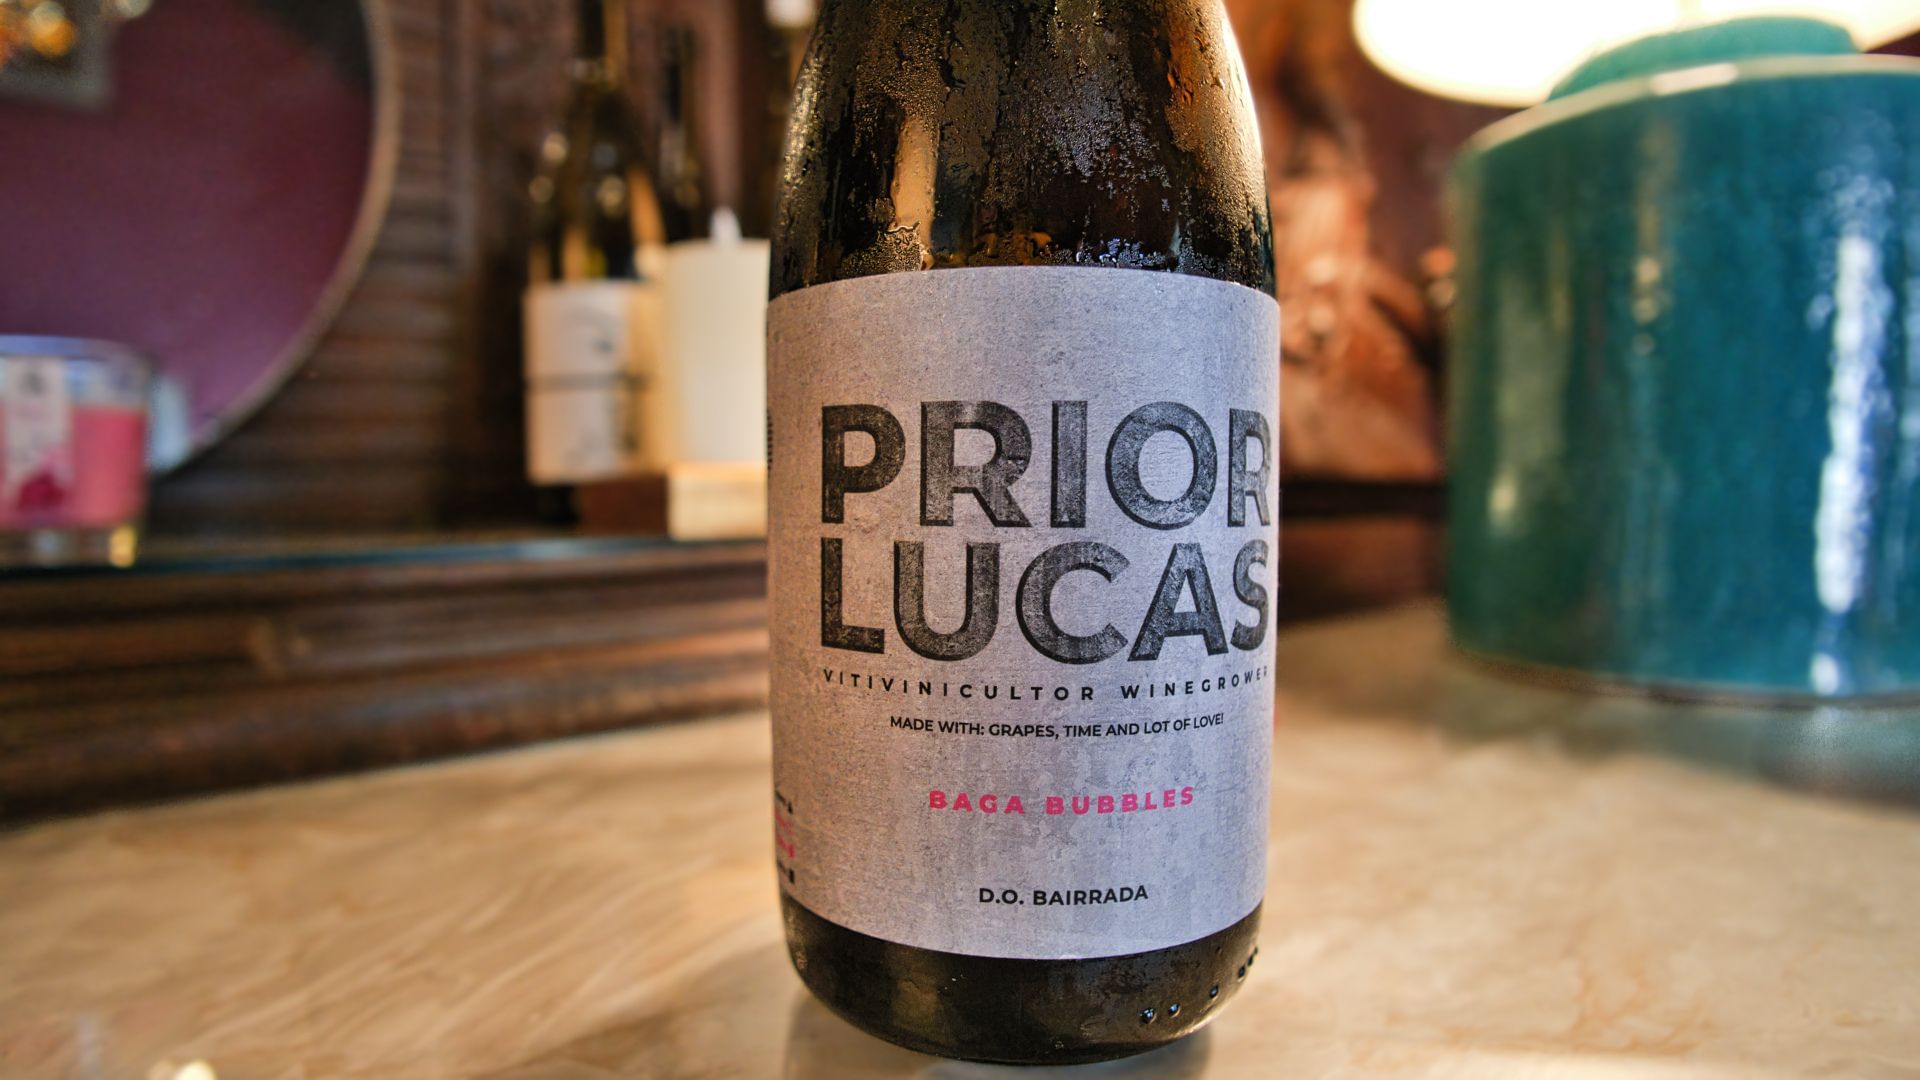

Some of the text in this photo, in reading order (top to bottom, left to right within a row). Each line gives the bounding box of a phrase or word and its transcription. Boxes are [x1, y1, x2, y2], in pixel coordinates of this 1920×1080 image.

[822, 400, 1272, 530] PRIOR
[822, 538, 1268, 664] LUCAS
[823, 668, 1095, 701] VITIVINICULTOR
[890, 712, 1225, 740] MADE WITH: GRAPES, TIME AND LOT OF LOVE!
[929, 786, 1195, 816] BAGA BUBBLES
[978, 885, 1148, 907] D.O. BAIRRADA
